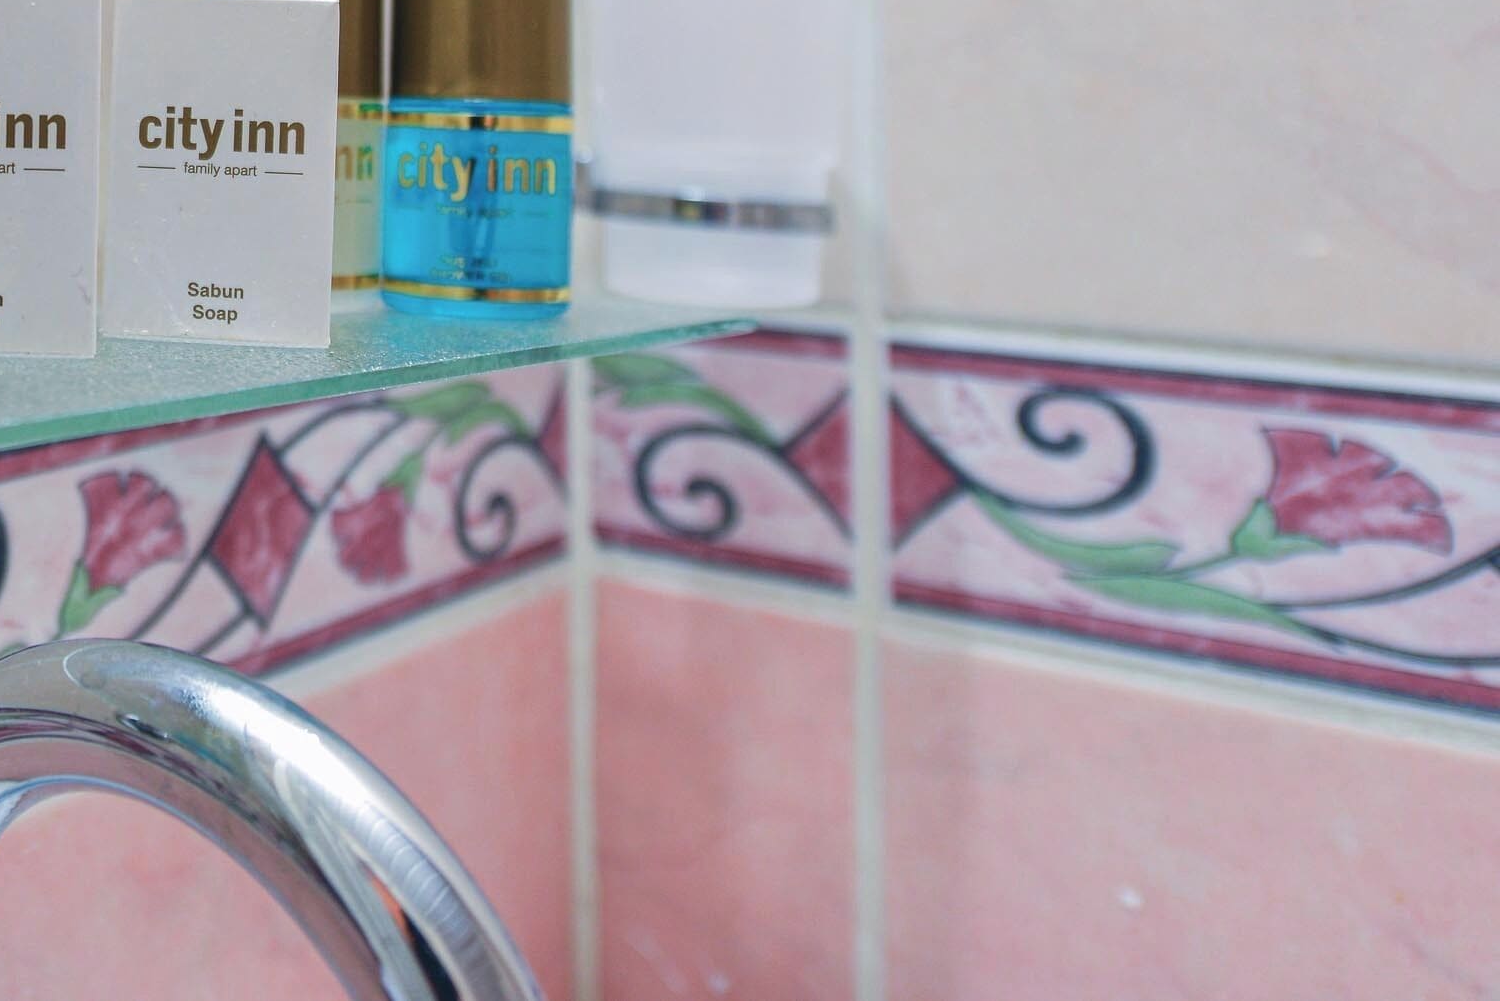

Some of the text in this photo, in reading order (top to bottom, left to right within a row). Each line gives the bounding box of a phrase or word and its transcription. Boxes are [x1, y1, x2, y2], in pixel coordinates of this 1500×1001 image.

[139, 106, 305, 160] city inn
[184, 162, 257, 178] family apart
[397, 142, 557, 202] city inn
[188, 282, 244, 299] Sabun
[193, 305, 238, 324] Soap
